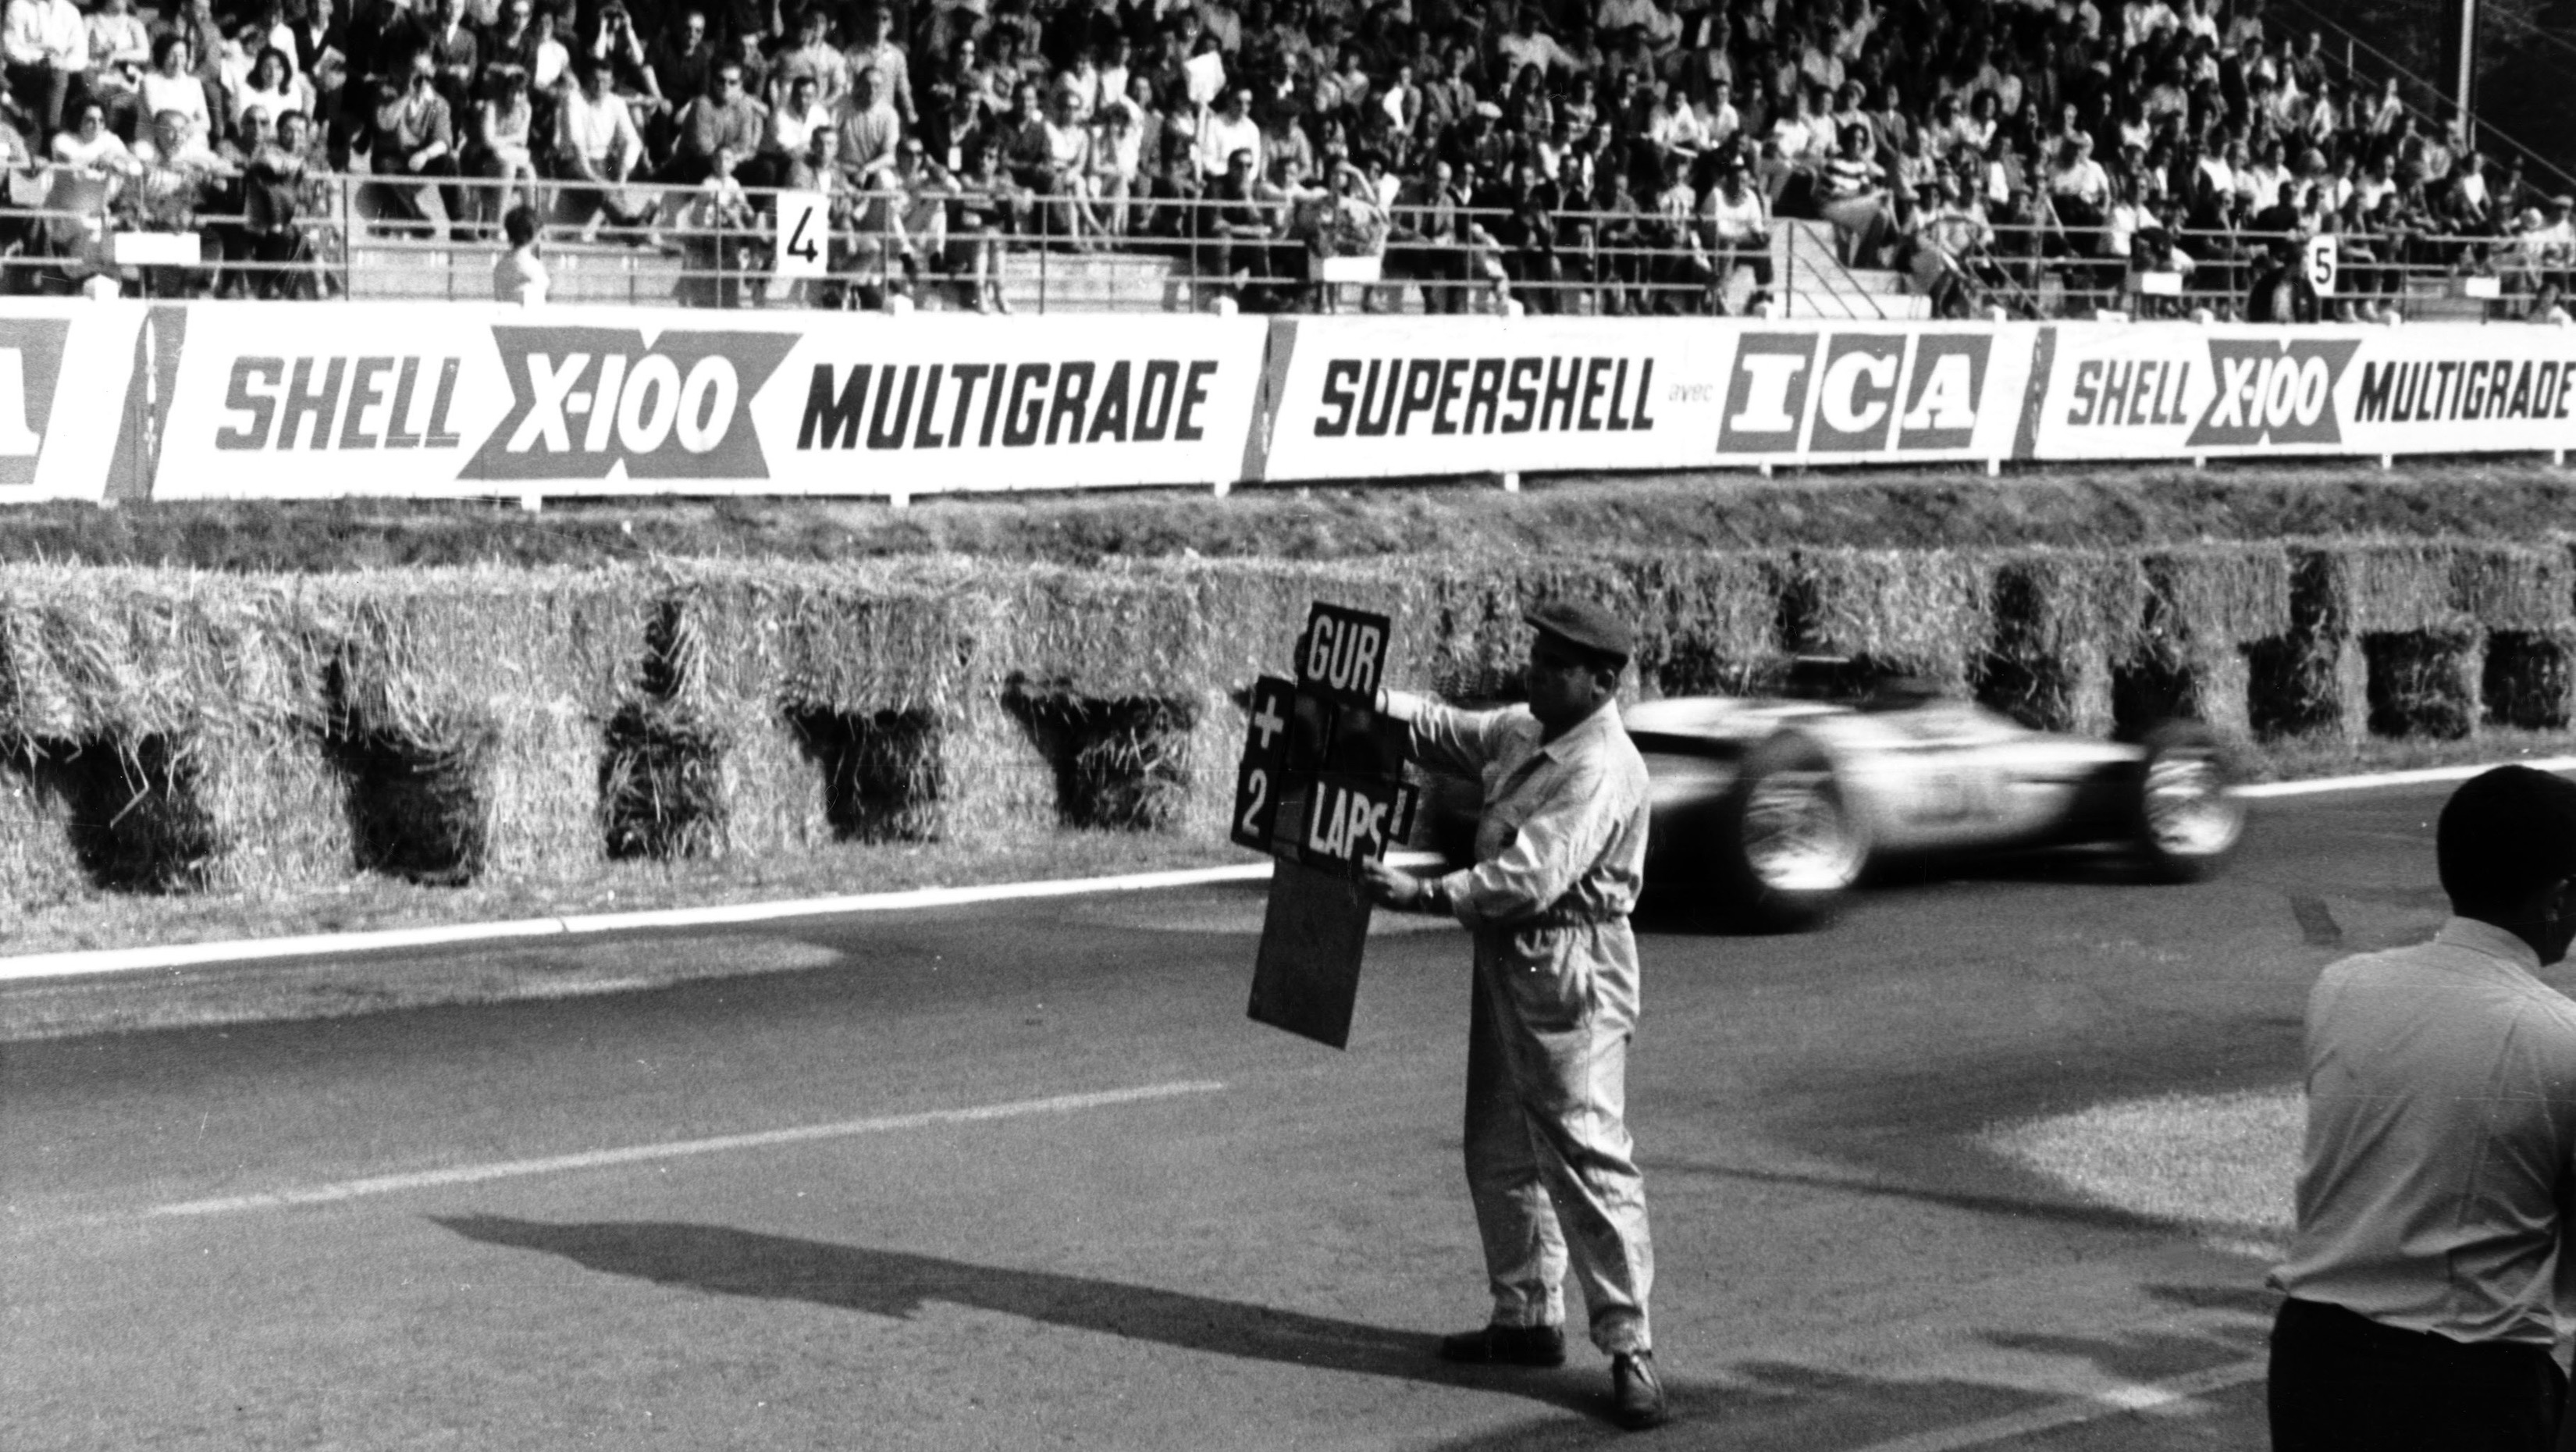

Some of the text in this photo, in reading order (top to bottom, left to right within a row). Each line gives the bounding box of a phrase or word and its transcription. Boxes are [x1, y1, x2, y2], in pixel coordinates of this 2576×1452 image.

[787, 206, 819, 263] 4
[2314, 247, 2332, 286] 5
[215, 357, 461, 450] SHELL
[506, 353, 738, 453] X-100
[796, 358, 1219, 450] MULTIGRADE
[1314, 356, 1654, 437] SUPERSHELL
[1667, 382, 1714, 405] avec
[1731, 351, 1975, 432] ICA
[2067, 359, 2191, 426] SHELL
[2209, 355, 2329, 428] X-100
[2354, 359, 2576, 424] MULTIGRADE
[1307, 614, 1381, 696] GUR
[1242, 769, 1268, 837] 2
[1309, 781, 1388, 862] LAPS
